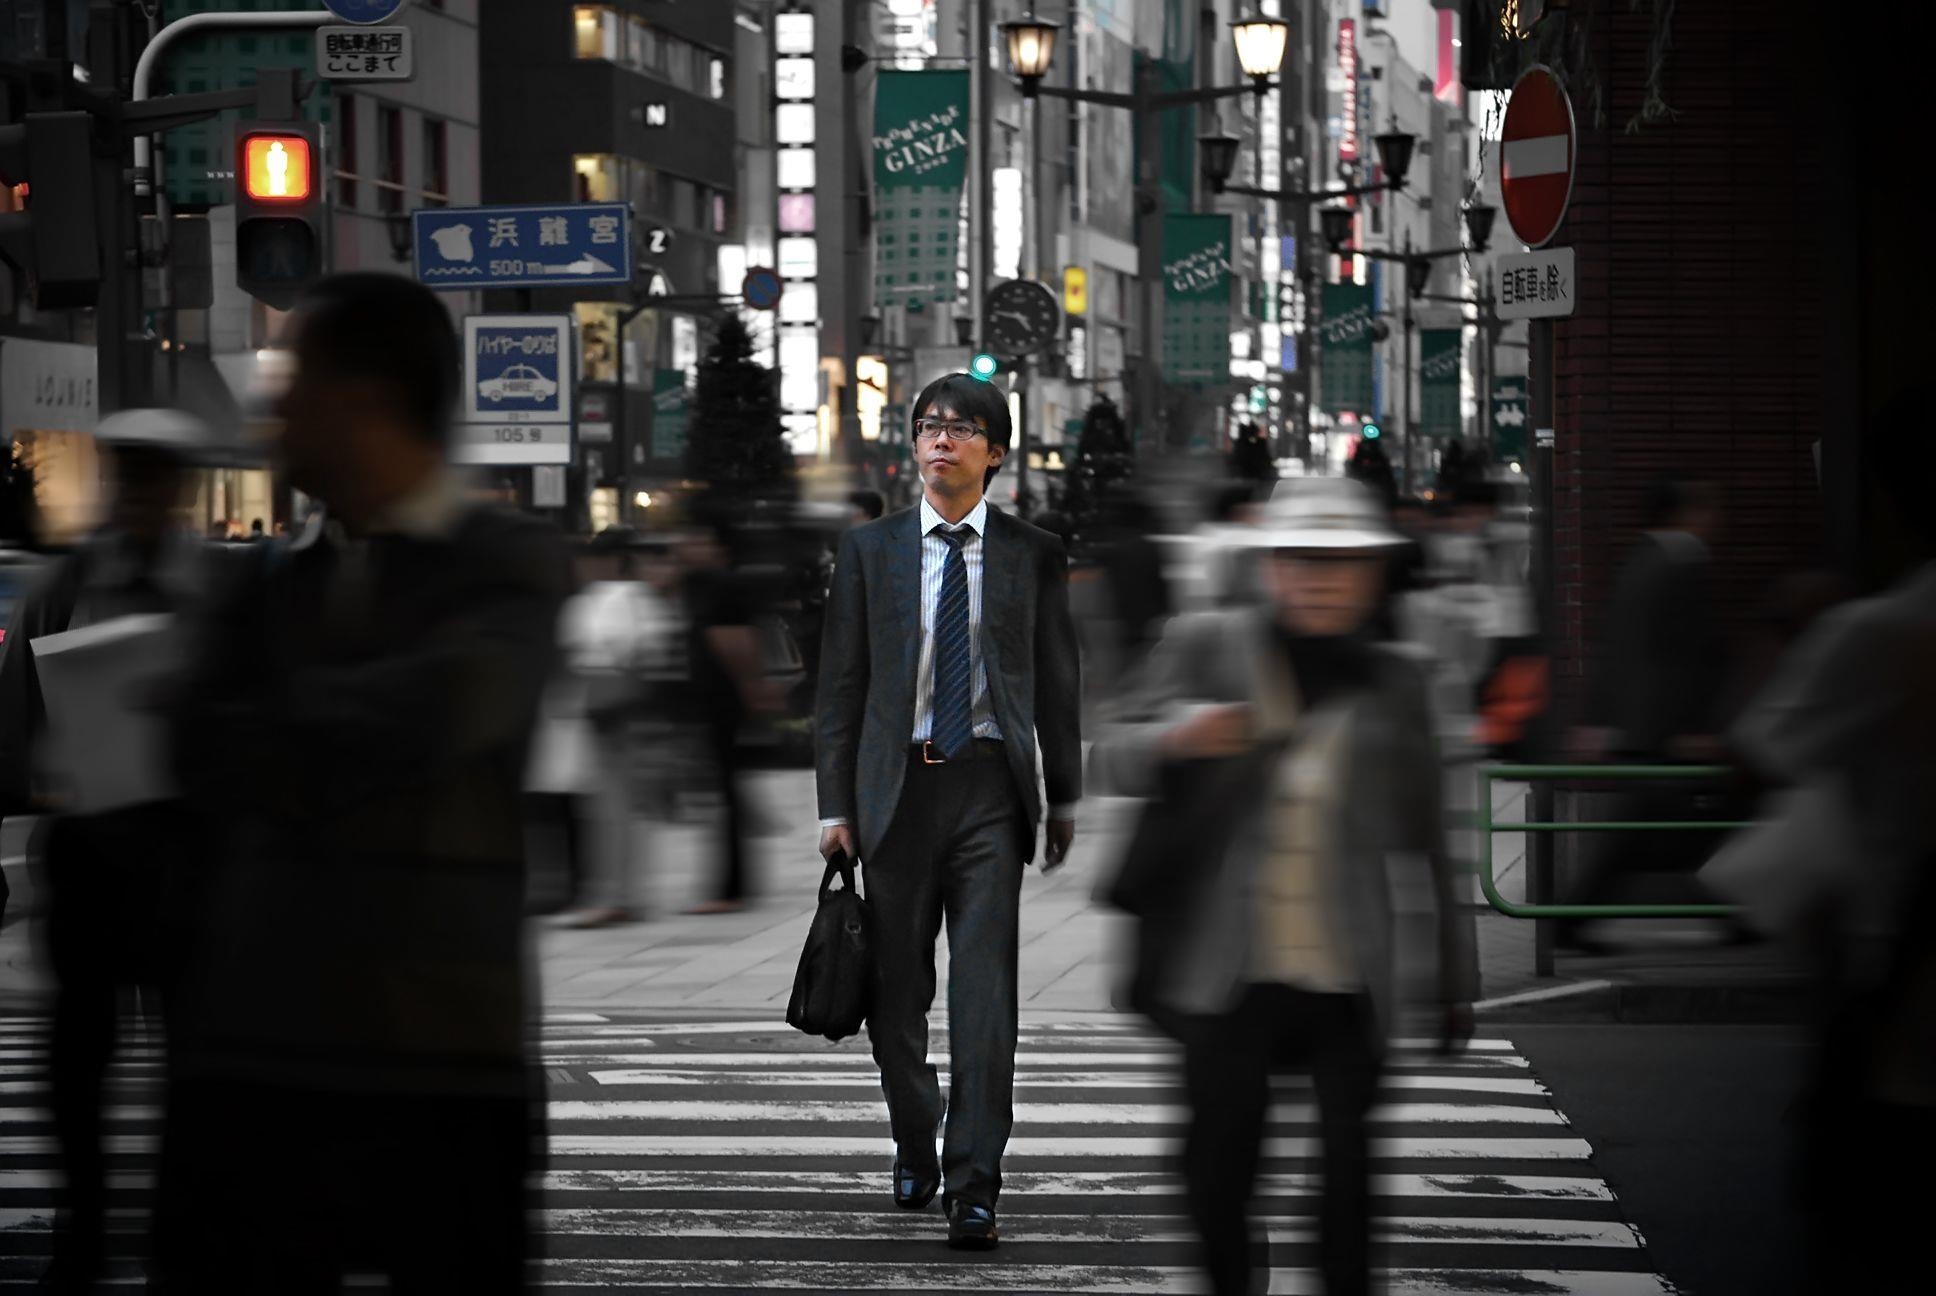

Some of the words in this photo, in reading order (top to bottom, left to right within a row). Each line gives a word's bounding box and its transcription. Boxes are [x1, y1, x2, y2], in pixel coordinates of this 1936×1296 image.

[885, 128, 967, 172] GINZA
[487, 214, 620, 248] 浜離宮
[489, 260, 524, 276] 500
[1173, 258, 1231, 291] GINZA
[1502, 264, 1568, 304] 自転車を除く
[494, 427, 523, 442] 105
